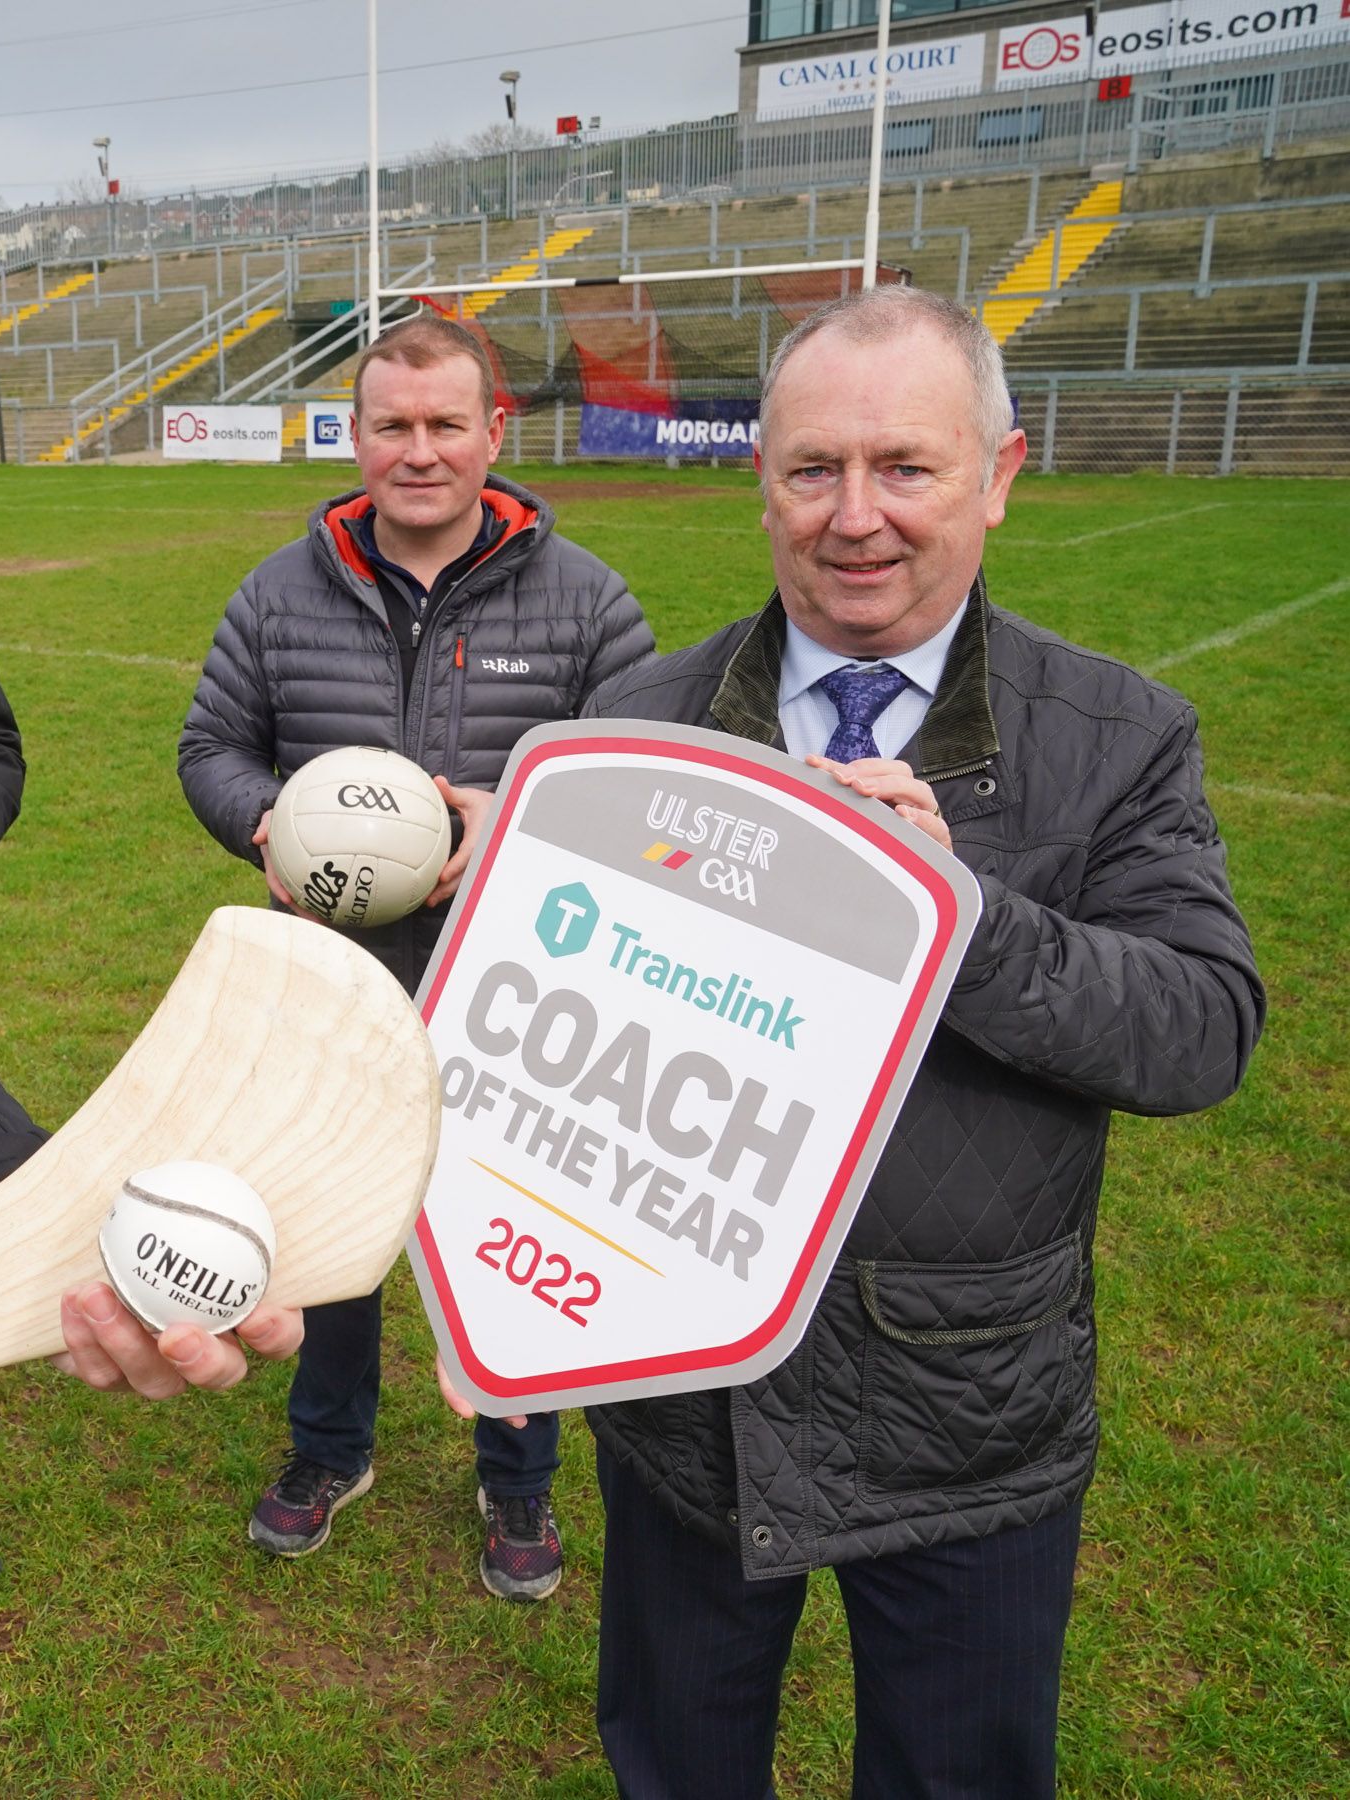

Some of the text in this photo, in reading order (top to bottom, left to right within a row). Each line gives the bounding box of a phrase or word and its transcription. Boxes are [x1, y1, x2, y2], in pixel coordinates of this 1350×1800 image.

[1001, 27, 1081, 70] EOS
[1098, 2, 1319, 57] eosits.com
[778, 44, 962, 87] CANAL COURT
[1106, 78, 1122, 97] B
[167, 412, 278, 443] EOS eosits.com
[496, 658, 530, 674] Rab
[338, 784, 401, 814] GAA
[646, 789, 779, 871] ULSTER
[699, 857, 757, 906] GAA
[609, 921, 806, 1051] Translink
[465, 960, 816, 1207] COACH
[441, 1056, 765, 1283] OF THE YEAR
[132, 1265, 234, 1319] ALL IRELAND
[137, 1233, 253, 1308] O'NEILLS
[475, 1217, 602, 1328] 2022
